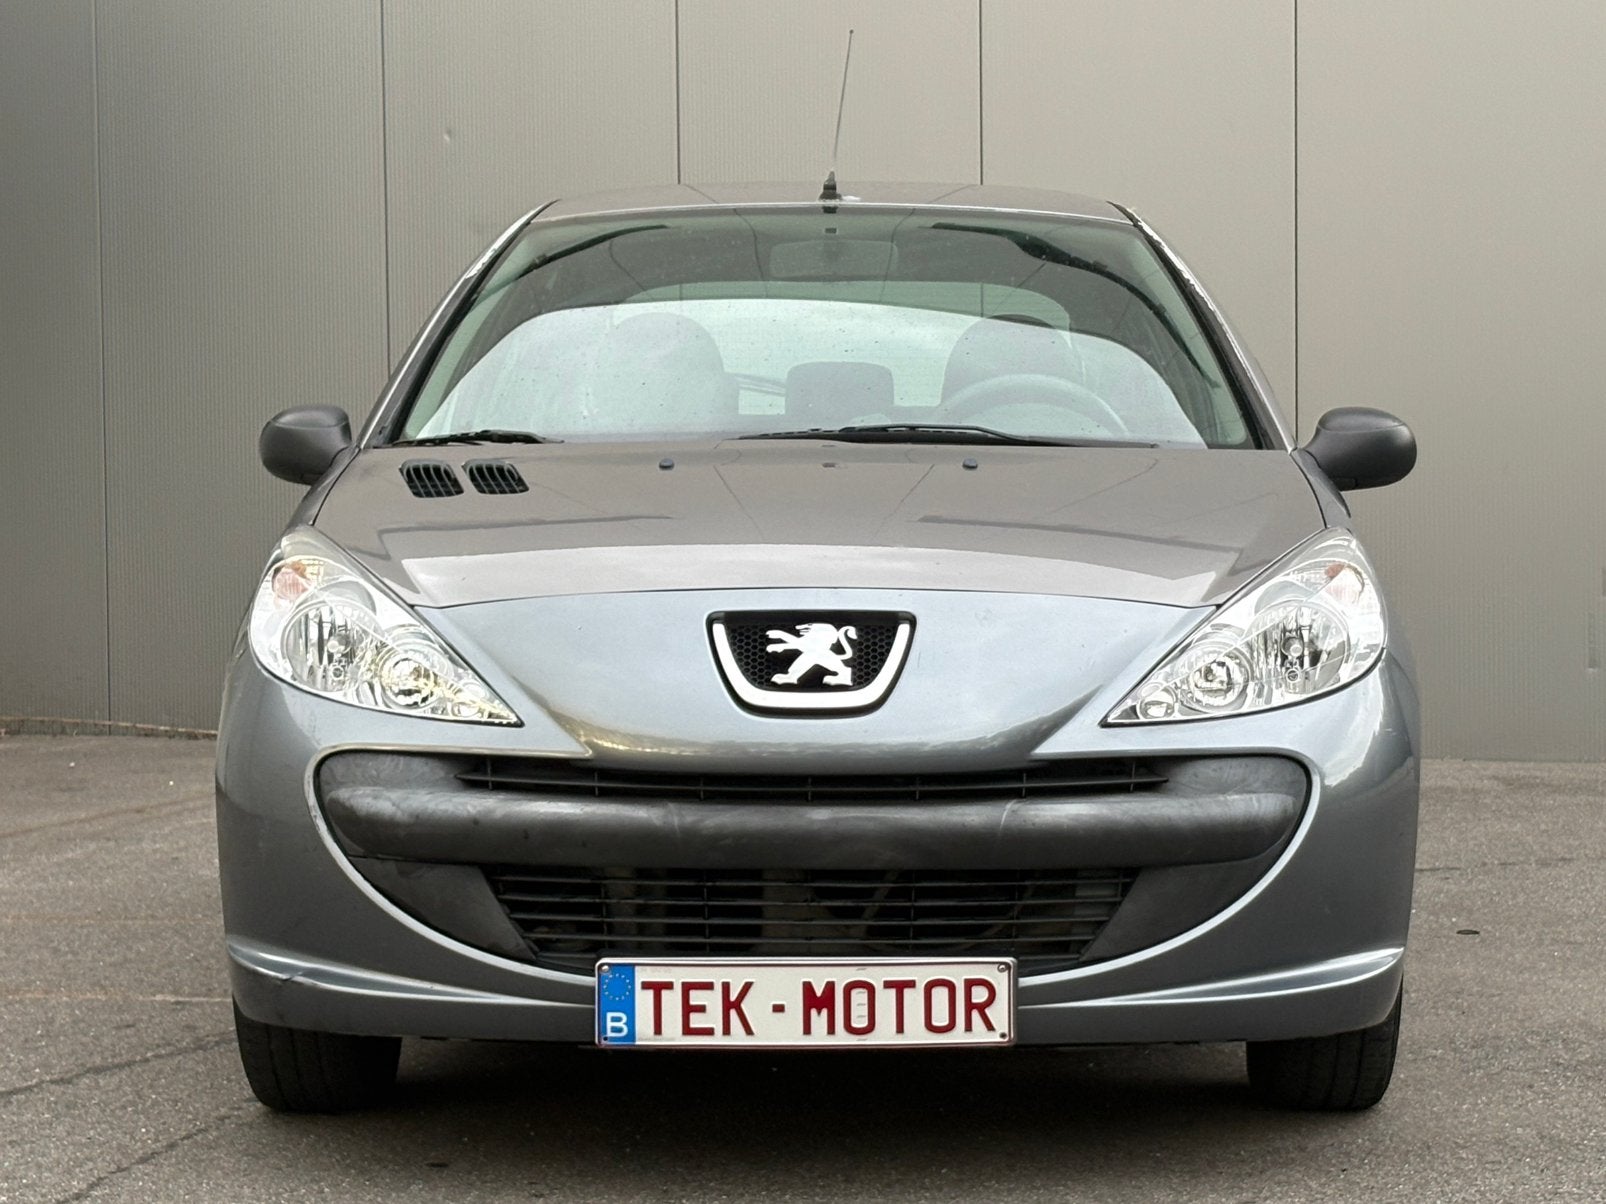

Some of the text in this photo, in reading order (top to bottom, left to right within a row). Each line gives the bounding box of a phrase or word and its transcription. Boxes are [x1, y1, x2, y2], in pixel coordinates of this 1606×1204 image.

[606, 1012, 628, 1037] B
[641, 981, 754, 1036] TEK
[802, 977, 996, 1035] MOTOR
